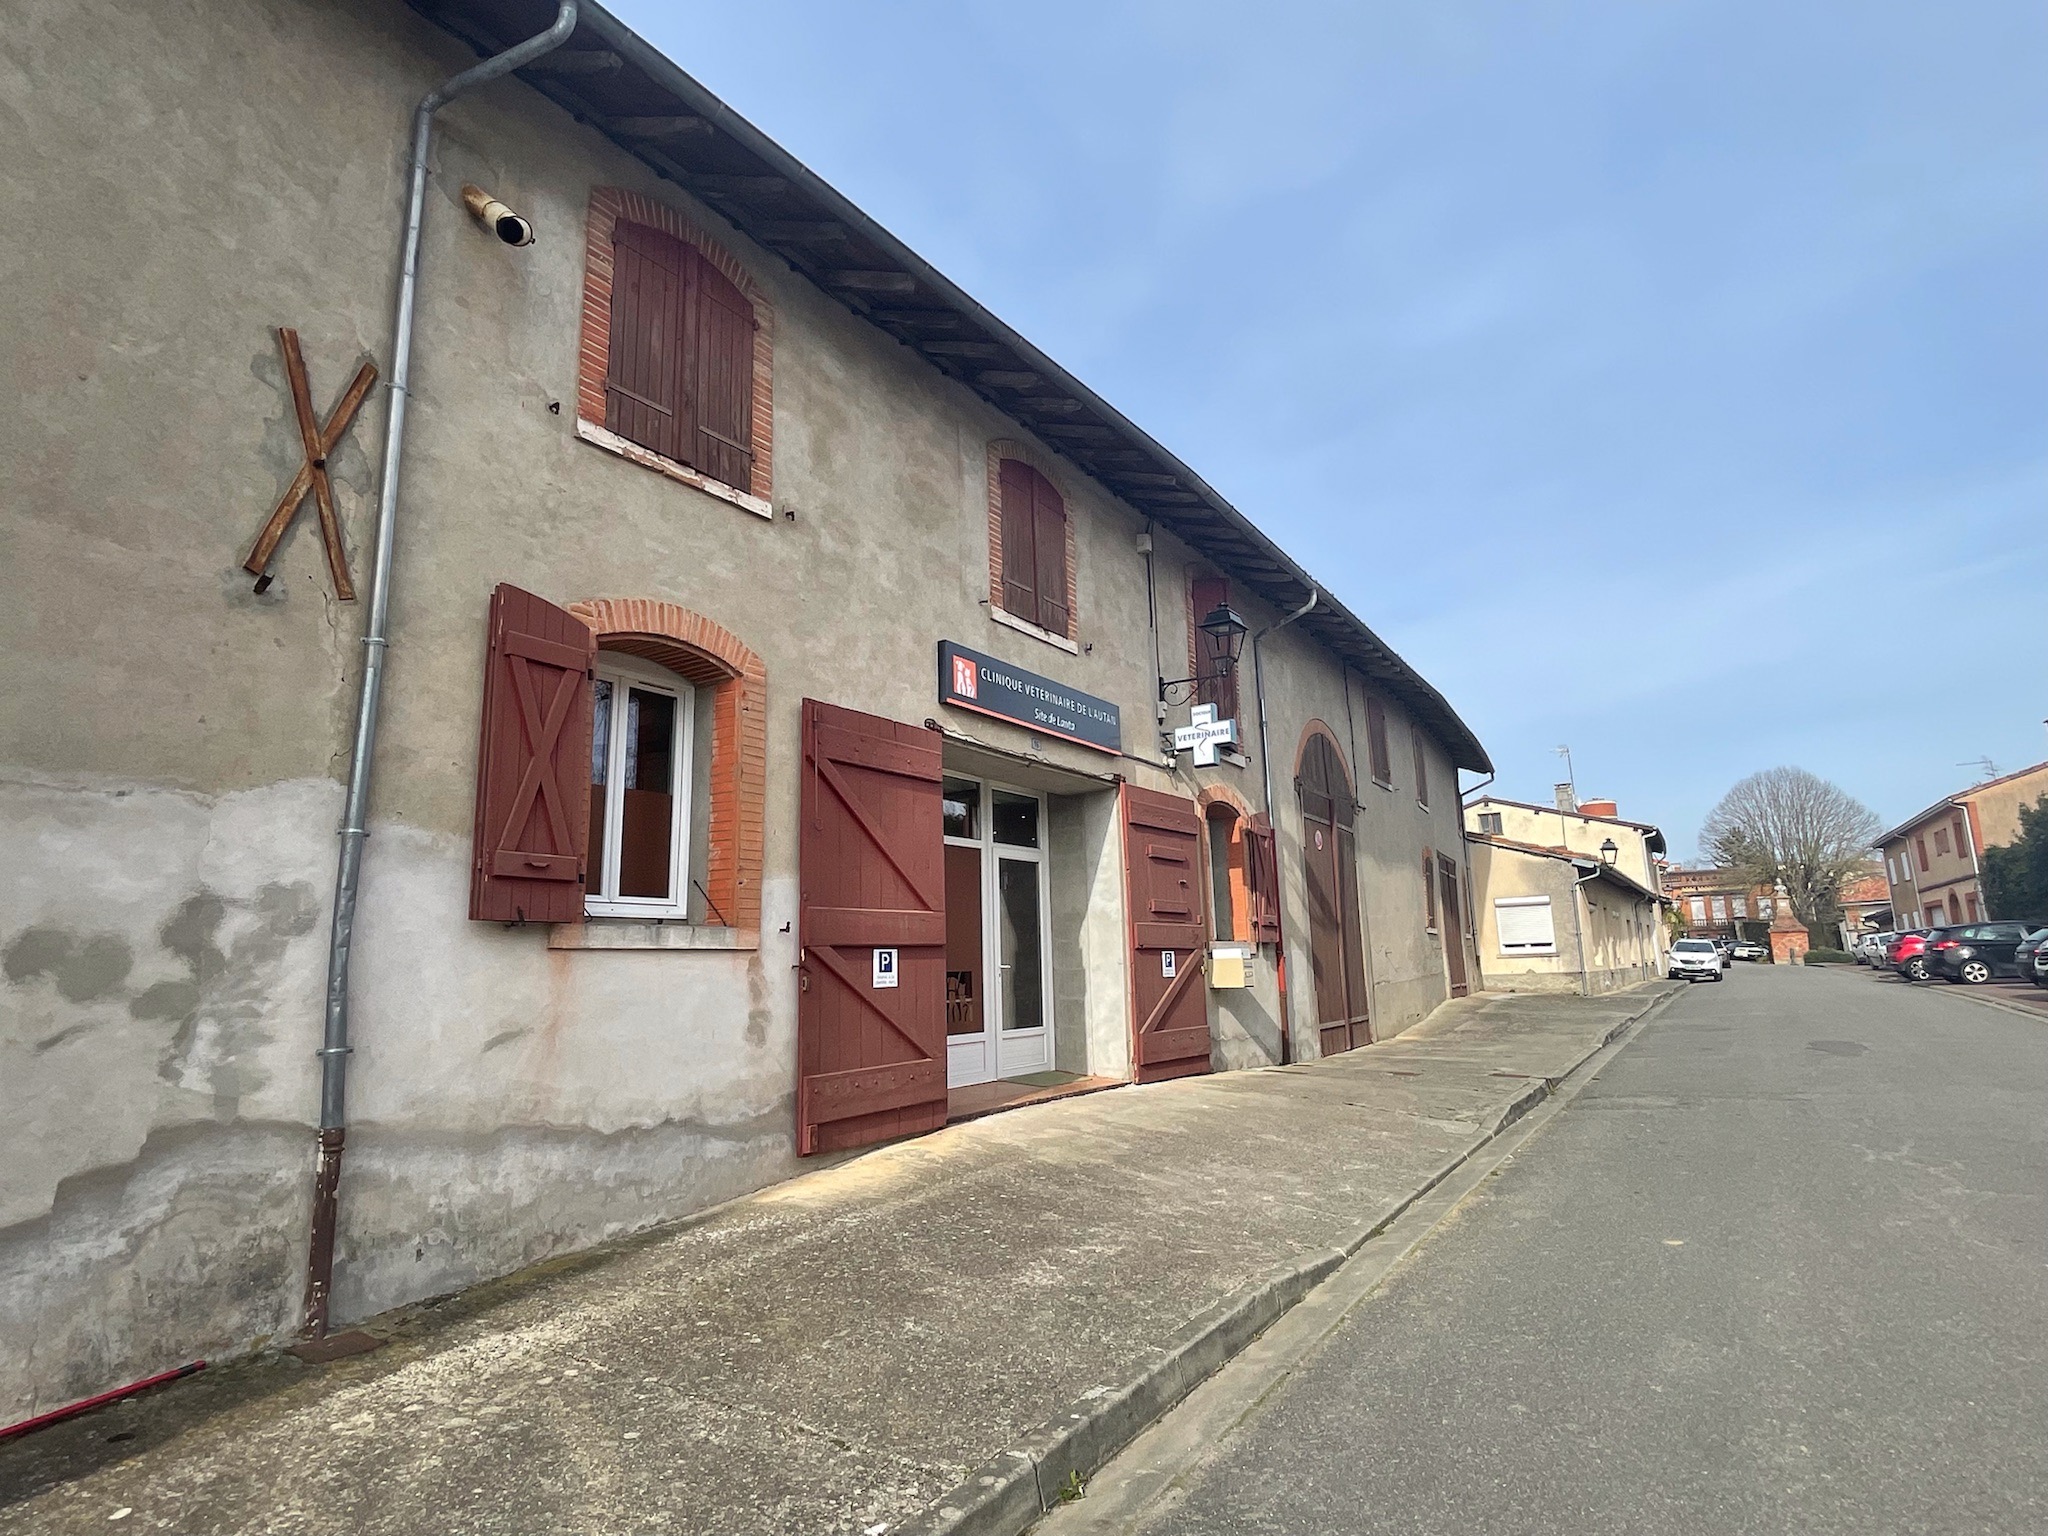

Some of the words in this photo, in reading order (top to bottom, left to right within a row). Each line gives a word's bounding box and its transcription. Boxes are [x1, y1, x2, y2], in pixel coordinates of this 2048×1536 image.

[980, 667, 1023, 693] CLINIQUE
[1077, 702, 1087, 716] DE
[1034, 708, 1048, 723] Site
[1048, 712, 1057, 725] de
[881, 953, 891, 971] P
